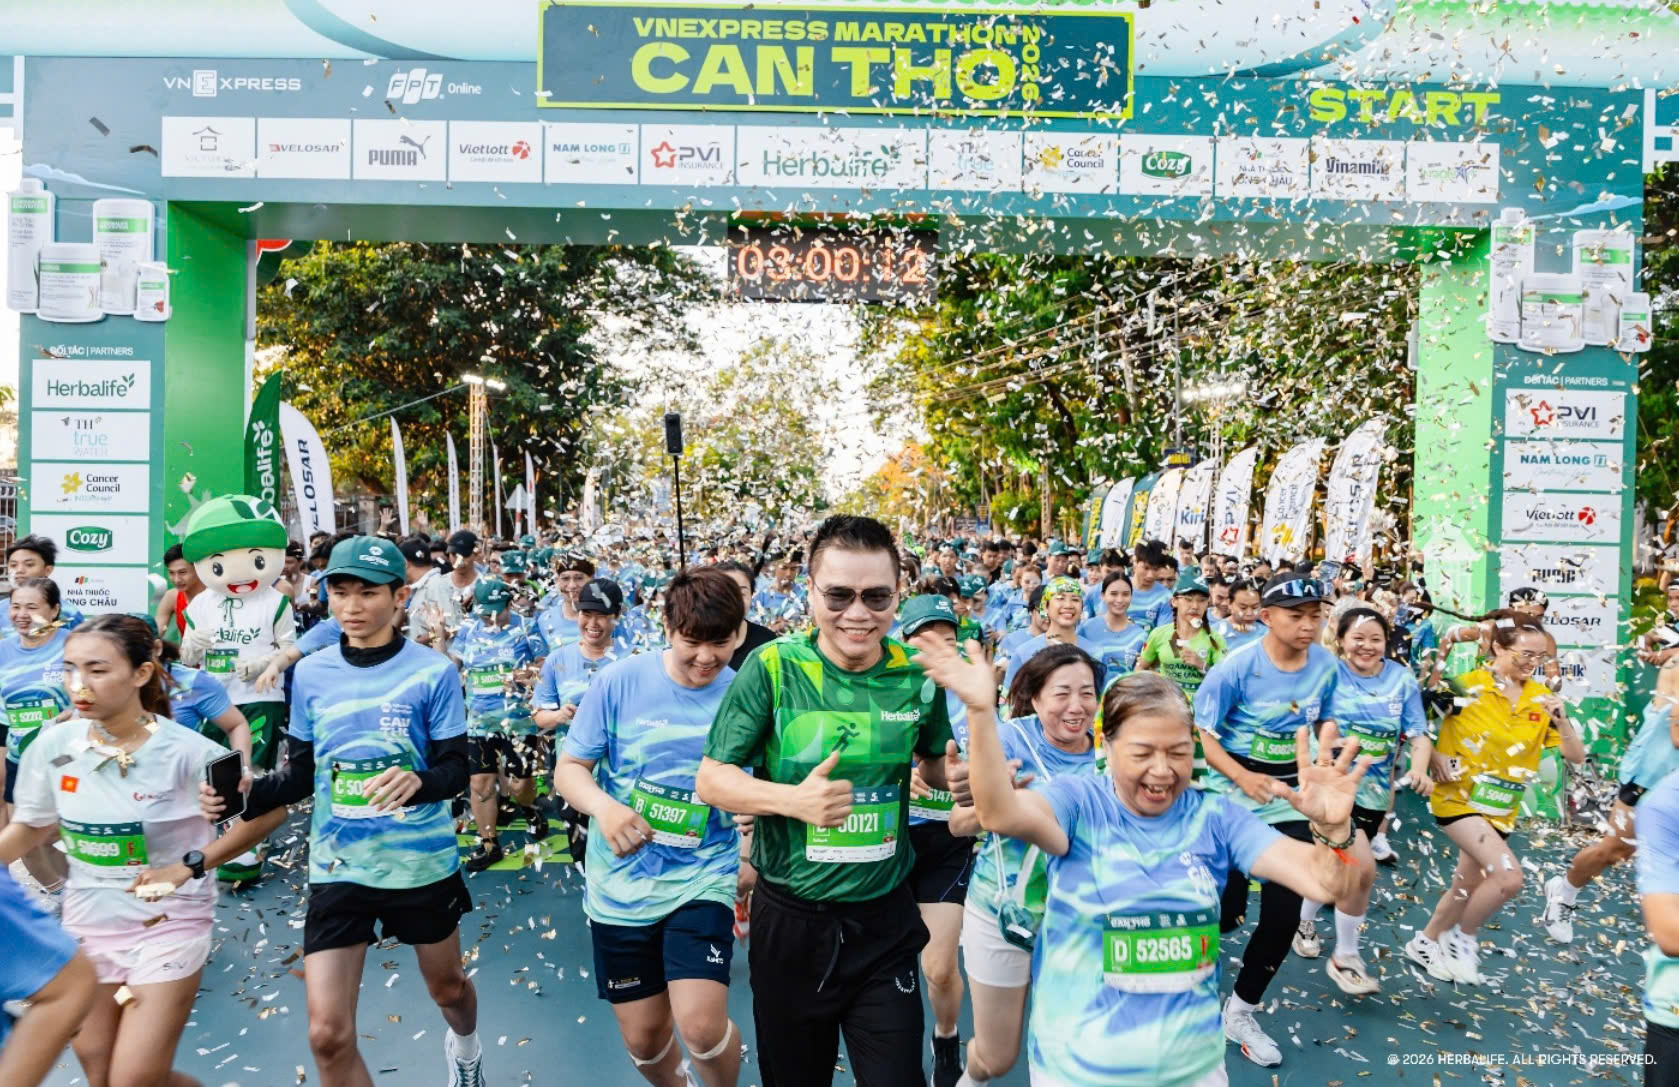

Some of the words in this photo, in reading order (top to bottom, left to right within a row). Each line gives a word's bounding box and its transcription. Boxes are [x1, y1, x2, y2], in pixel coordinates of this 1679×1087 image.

[633, 17, 828, 42] VNEXPRESS
[834, 23, 1017, 46] MARATHON
[631, 43, 815, 96] CAN
[832, 46, 1017, 101] THO
[163, 70, 301, 97] VNEXPRESS
[388, 70, 443, 103] FPT
[447, 82, 483, 96] Online
[1309, 88, 1501, 126] START
[459, 143, 509, 155] Vietlott
[553, 143, 580, 153] NAM
[584, 144, 616, 153] LONG
[679, 146, 721, 162] PVI
[368, 149, 418, 167] PUMA
[678, 161, 724, 170] INSURANCE
[763, 149, 888, 177] Herbalife
[1067, 158, 1104, 169] Council
[1145, 154, 1191, 175] Cozy
[737, 246, 928, 284] 03:00:12
[90, 347, 134, 356] PARTNERS
[47, 379, 128, 398] Herbalife
[1564, 376, 1609, 387] PARTNERS
[1557, 406, 1596, 420] PVI
[74, 431, 109, 446] true
[1520, 454, 1551, 465] NAM
[1555, 455, 1591, 465] LONG
[86, 474, 119, 483] Cancer
[86, 483, 121, 493] Council
[69, 530, 108, 549] Cozy
[67, 588, 83, 596] NHÀ
[89, 596, 117, 607] CHÂU
[880, 710, 919, 722] Herbalife
[335, 778, 345, 795] C
[927, 788, 955, 802] 5147
[635, 798, 645, 814] B
[649, 803, 687, 824] 51397
[1114, 939, 1128, 963] D
